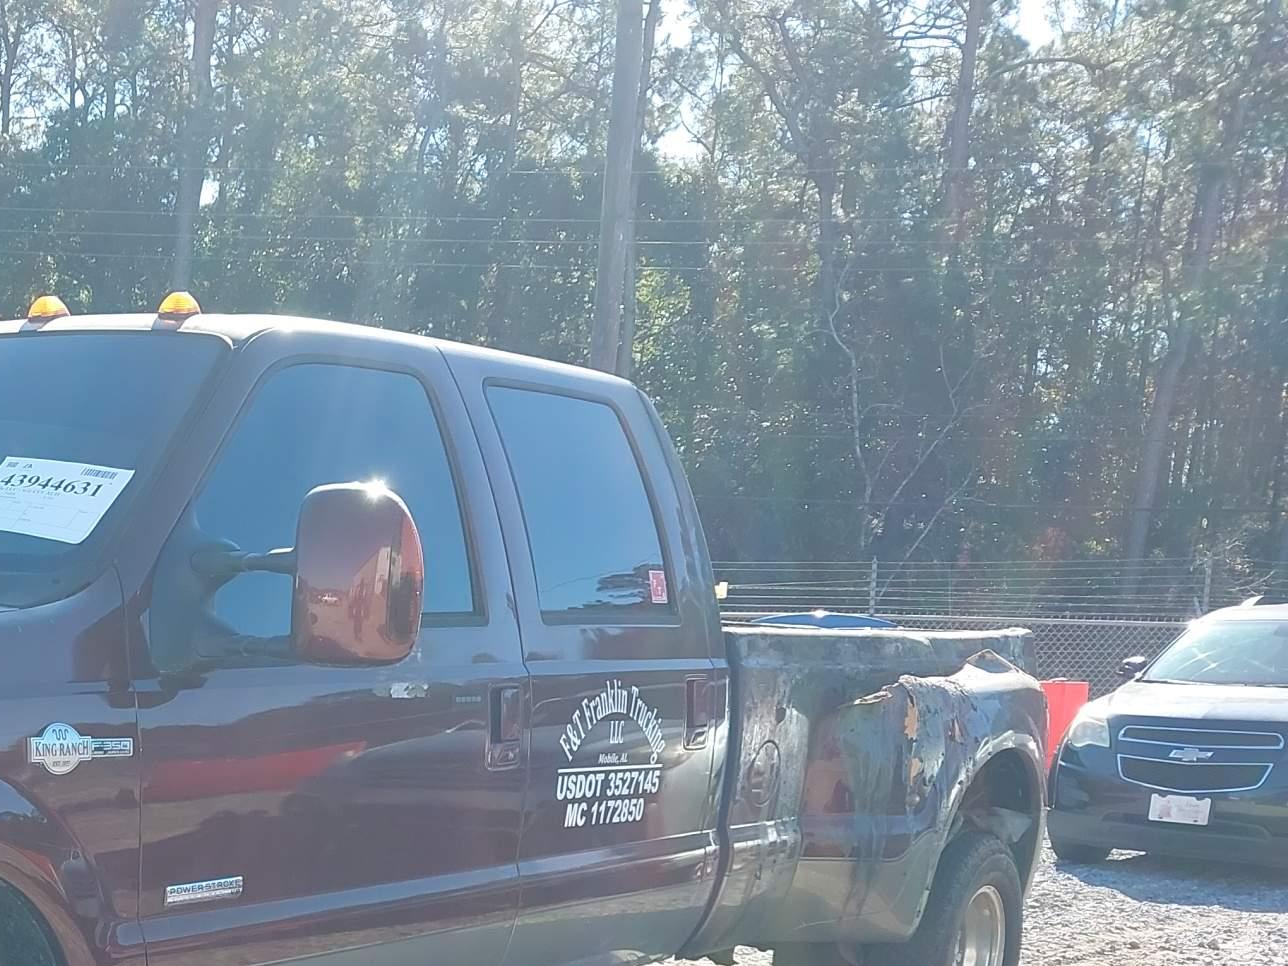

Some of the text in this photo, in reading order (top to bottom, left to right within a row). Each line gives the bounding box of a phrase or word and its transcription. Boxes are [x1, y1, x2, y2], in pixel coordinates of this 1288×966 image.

[0, 473, 104, 497] 43944631
[581, 679, 628, 730] Franklin
[629, 685, 665, 765] Trucking
[609, 720, 625, 744] LLC
[35, 740, 89, 758] KING RANCH
[556, 770, 660, 800] USDOT 3527145
[564, 798, 645, 828] MC 1172850
